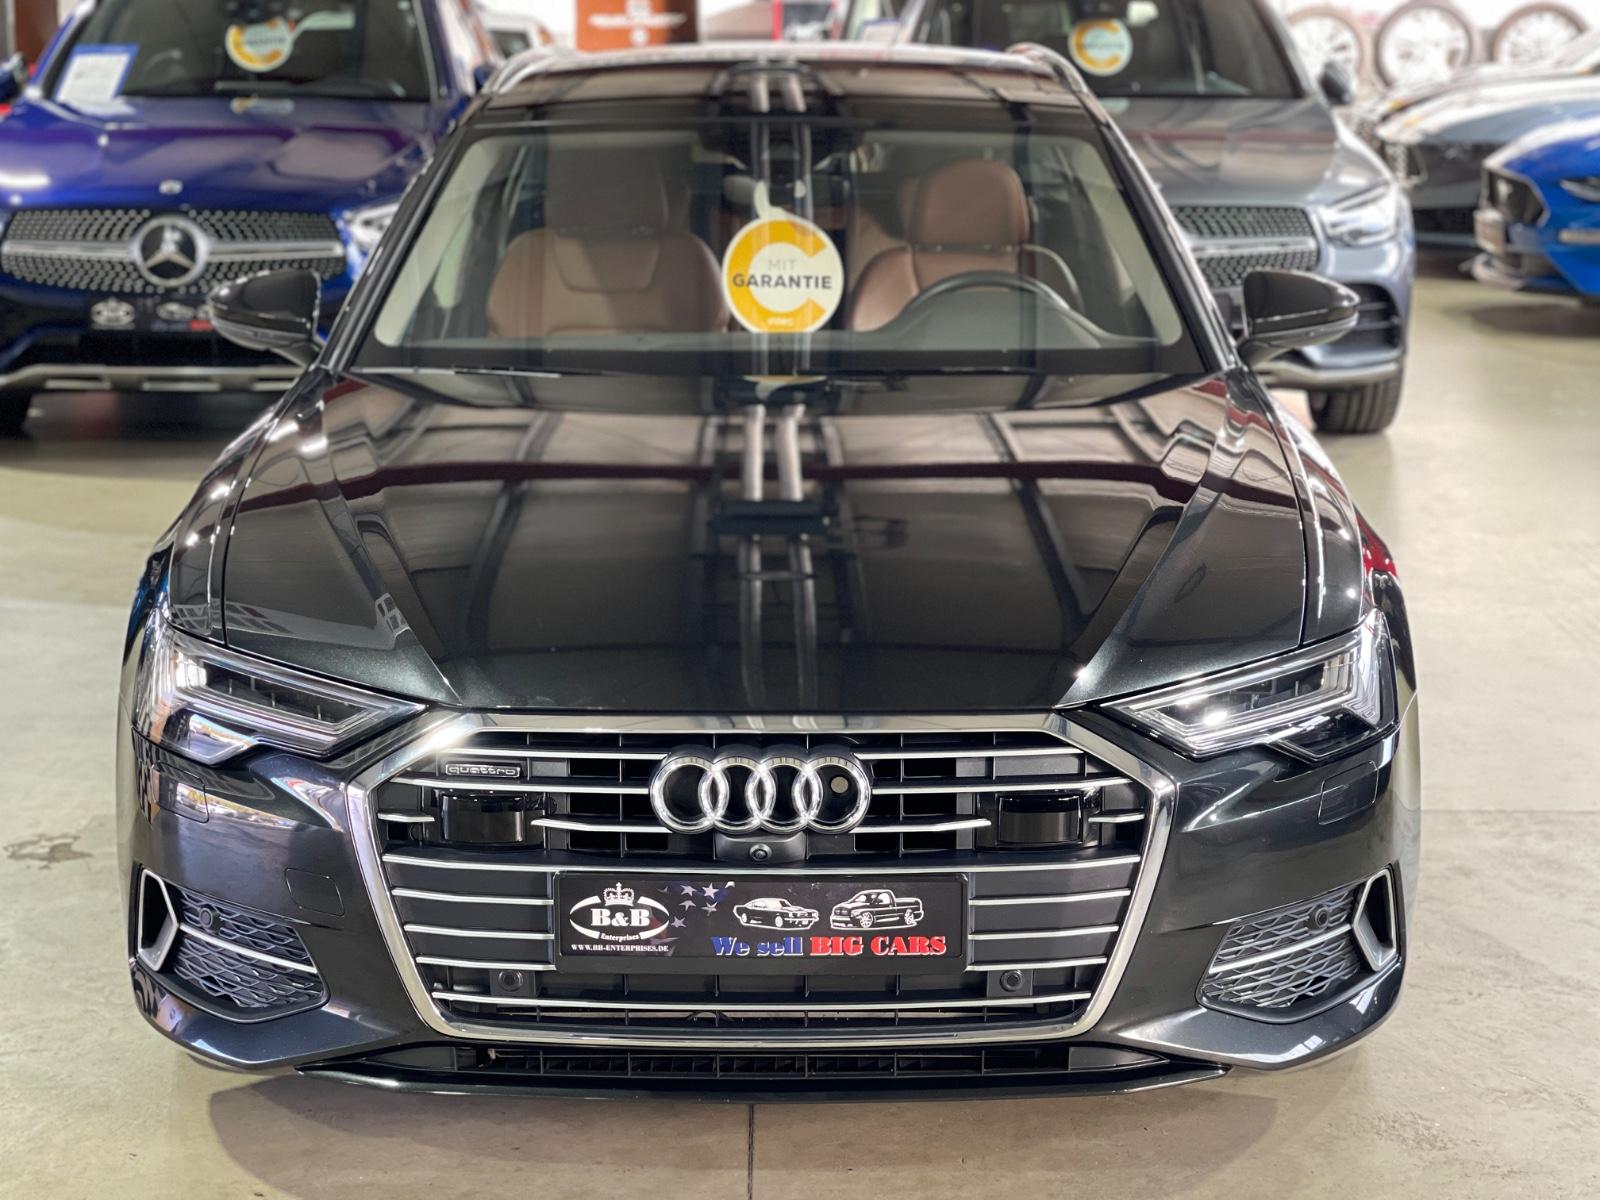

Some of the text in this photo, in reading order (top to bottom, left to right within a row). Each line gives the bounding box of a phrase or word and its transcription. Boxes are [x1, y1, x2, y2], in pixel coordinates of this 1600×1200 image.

[768, 258, 796, 272] MIT
[732, 273, 832, 289] GARANTIE
[449, 766, 516, 776] quattro
[590, 908, 650, 927] B&B
[600, 933, 640, 943] Enterprises
[570, 944, 669, 952] WWW.BB-ENTERPRISES.DE
[711, 936, 947, 957] We sell BIG CARS
